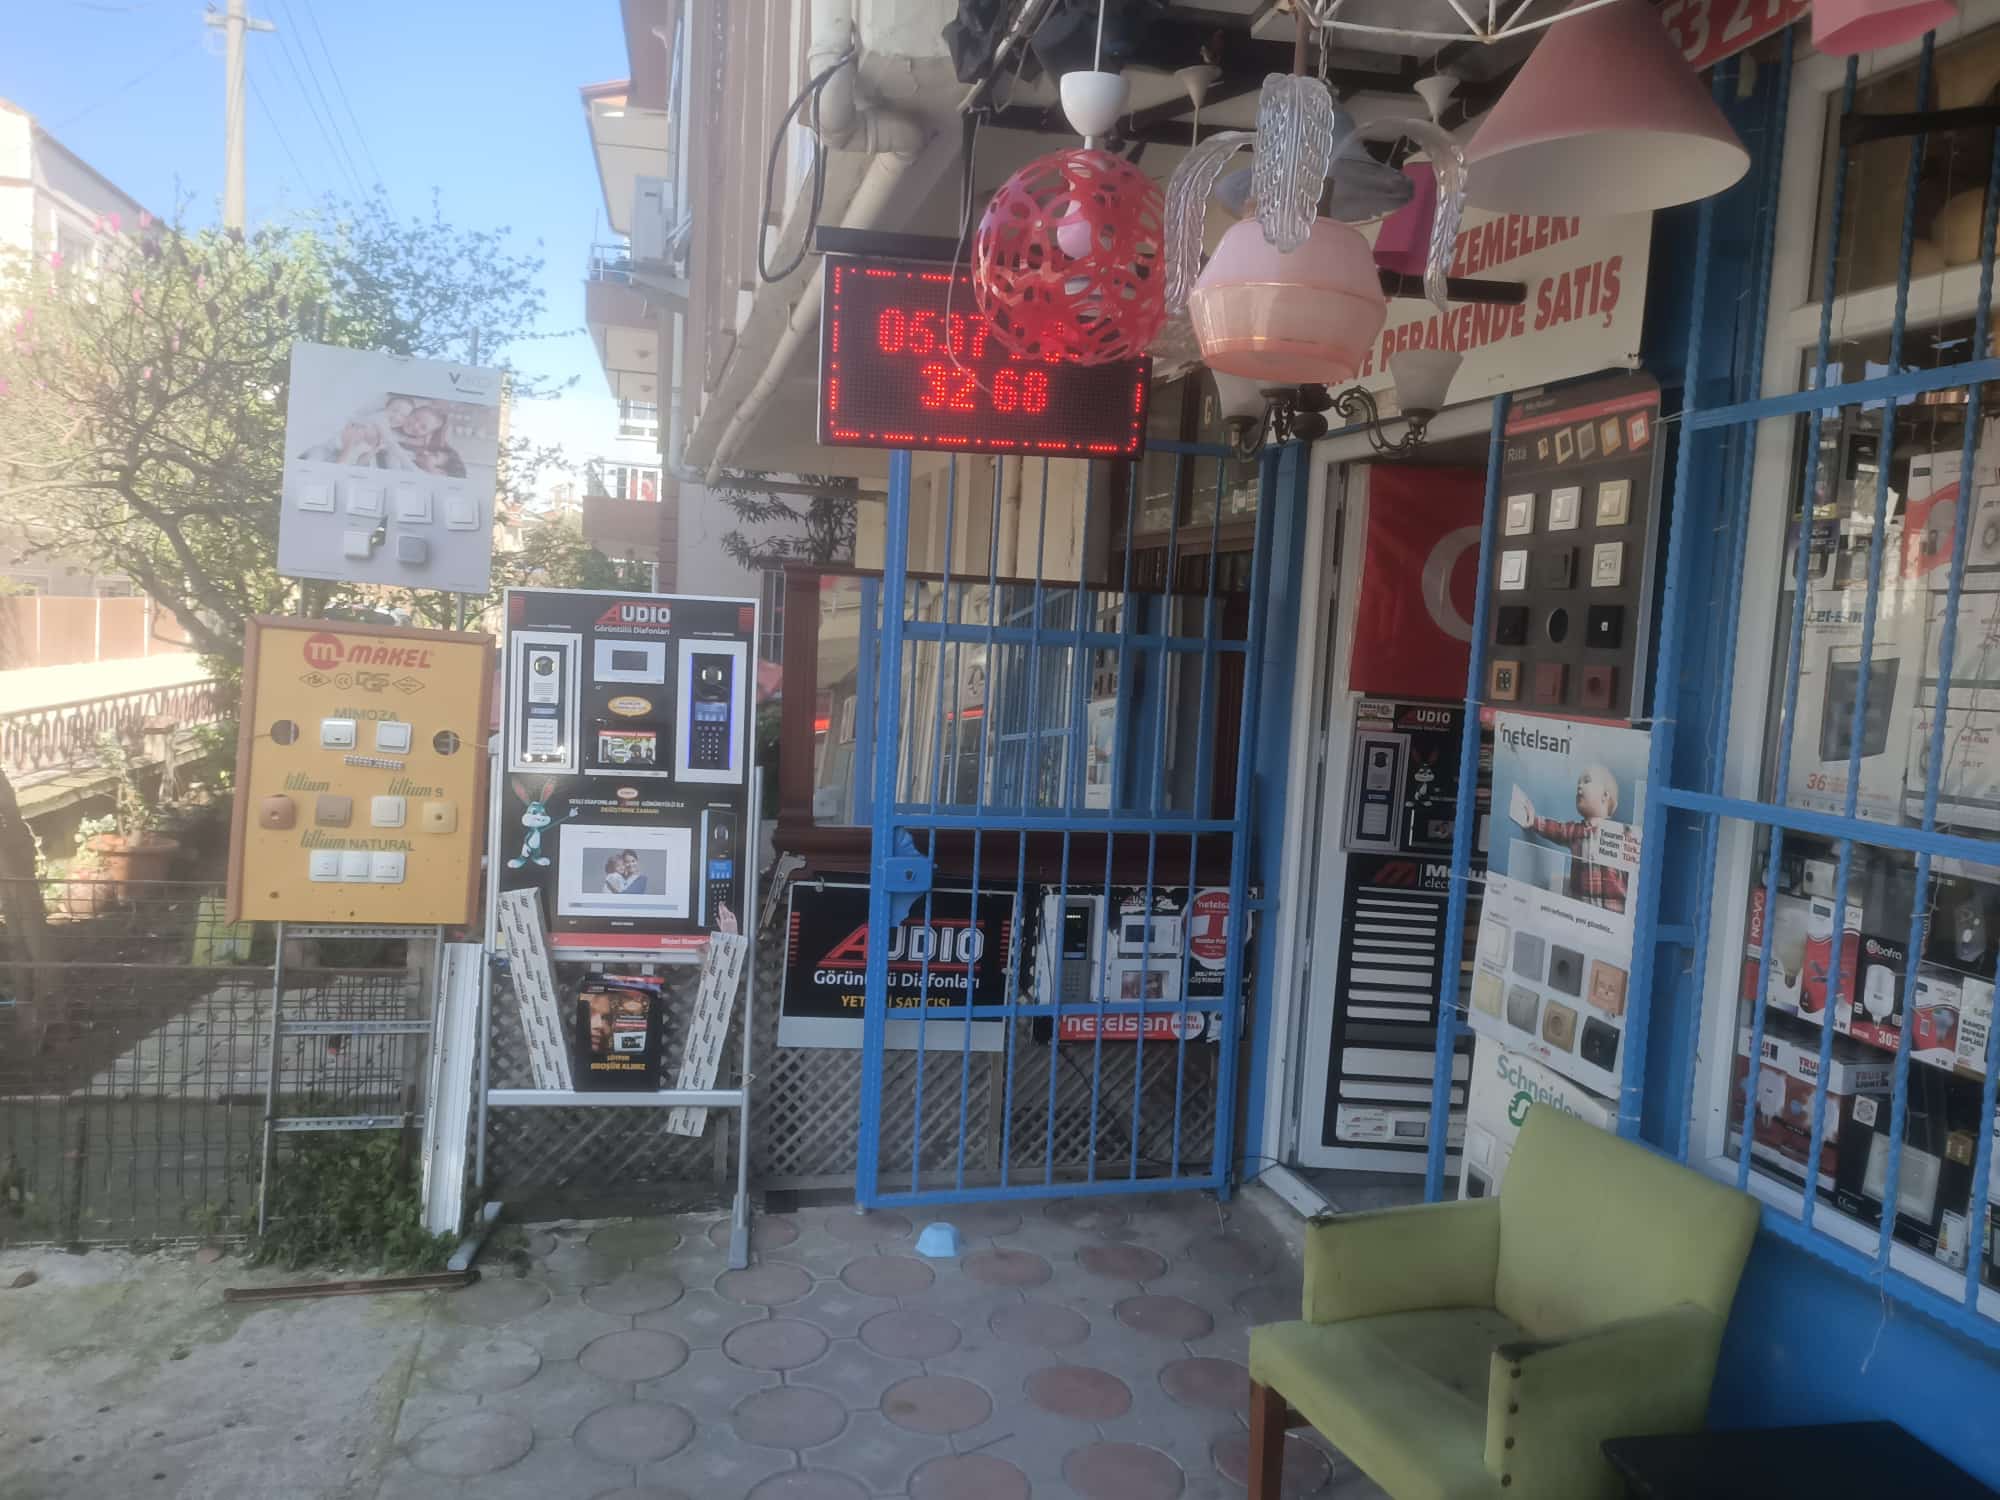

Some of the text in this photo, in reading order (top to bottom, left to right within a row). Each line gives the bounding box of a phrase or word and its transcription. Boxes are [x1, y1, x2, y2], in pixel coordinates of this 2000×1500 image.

[1534, 256, 1623, 329] SATIŞ
[920, 362, 1049, 413] 32 68
[596, 602, 672, 624] AUDIO
